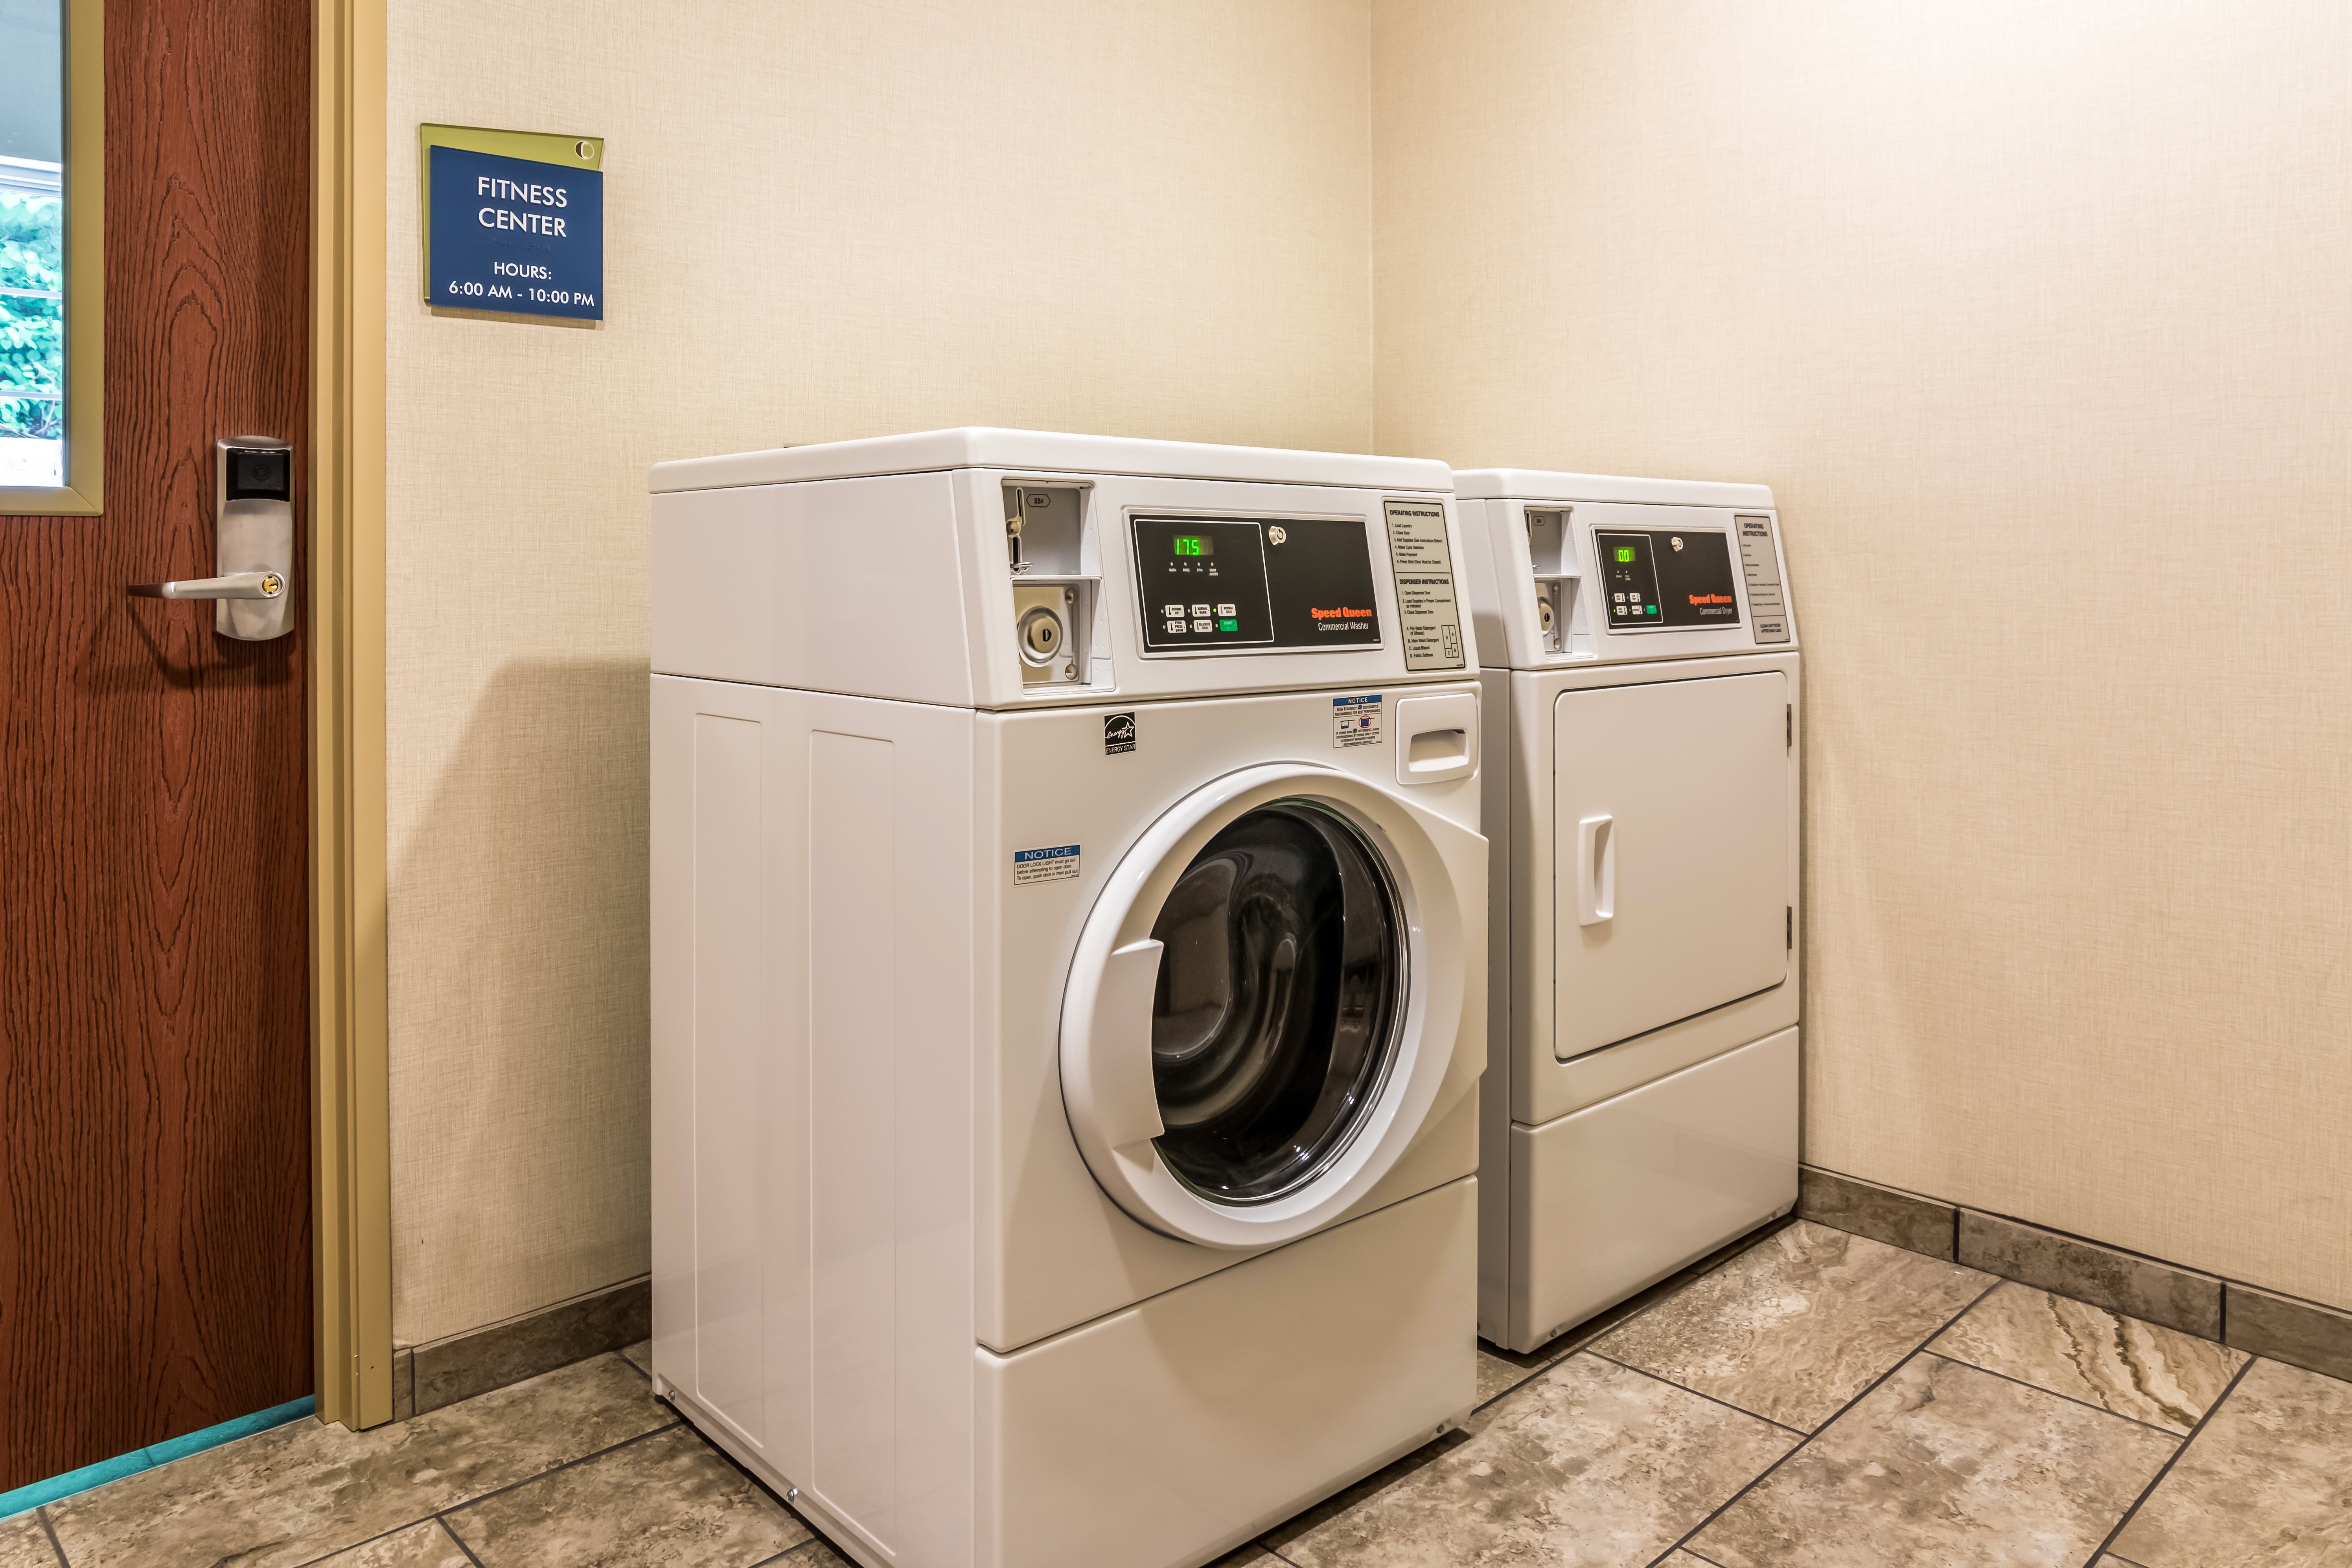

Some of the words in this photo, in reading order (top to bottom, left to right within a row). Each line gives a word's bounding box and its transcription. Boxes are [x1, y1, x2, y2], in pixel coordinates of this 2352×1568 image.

[478, 176, 567, 208] FITNESS
[478, 208, 566, 237] CENTER
[494, 262, 552, 279] HOURS:
[449, 281, 483, 296] 6:00
[488, 285, 512, 298] AM
[529, 289, 569, 304] 10:00
[574, 293, 594, 306] PM
[1176, 539, 1199, 555] 175
[1689, 594, 1710, 606] Speed
[1711, 594, 1732, 603] Queen
[1311, 607, 1341, 620] Speed
[1343, 607, 1372, 617] Queen
[1723, 607, 1732, 616] Dryer
[1318, 622, 1349, 631] Commercial
[1025, 847, 1071, 859] NOTICE
